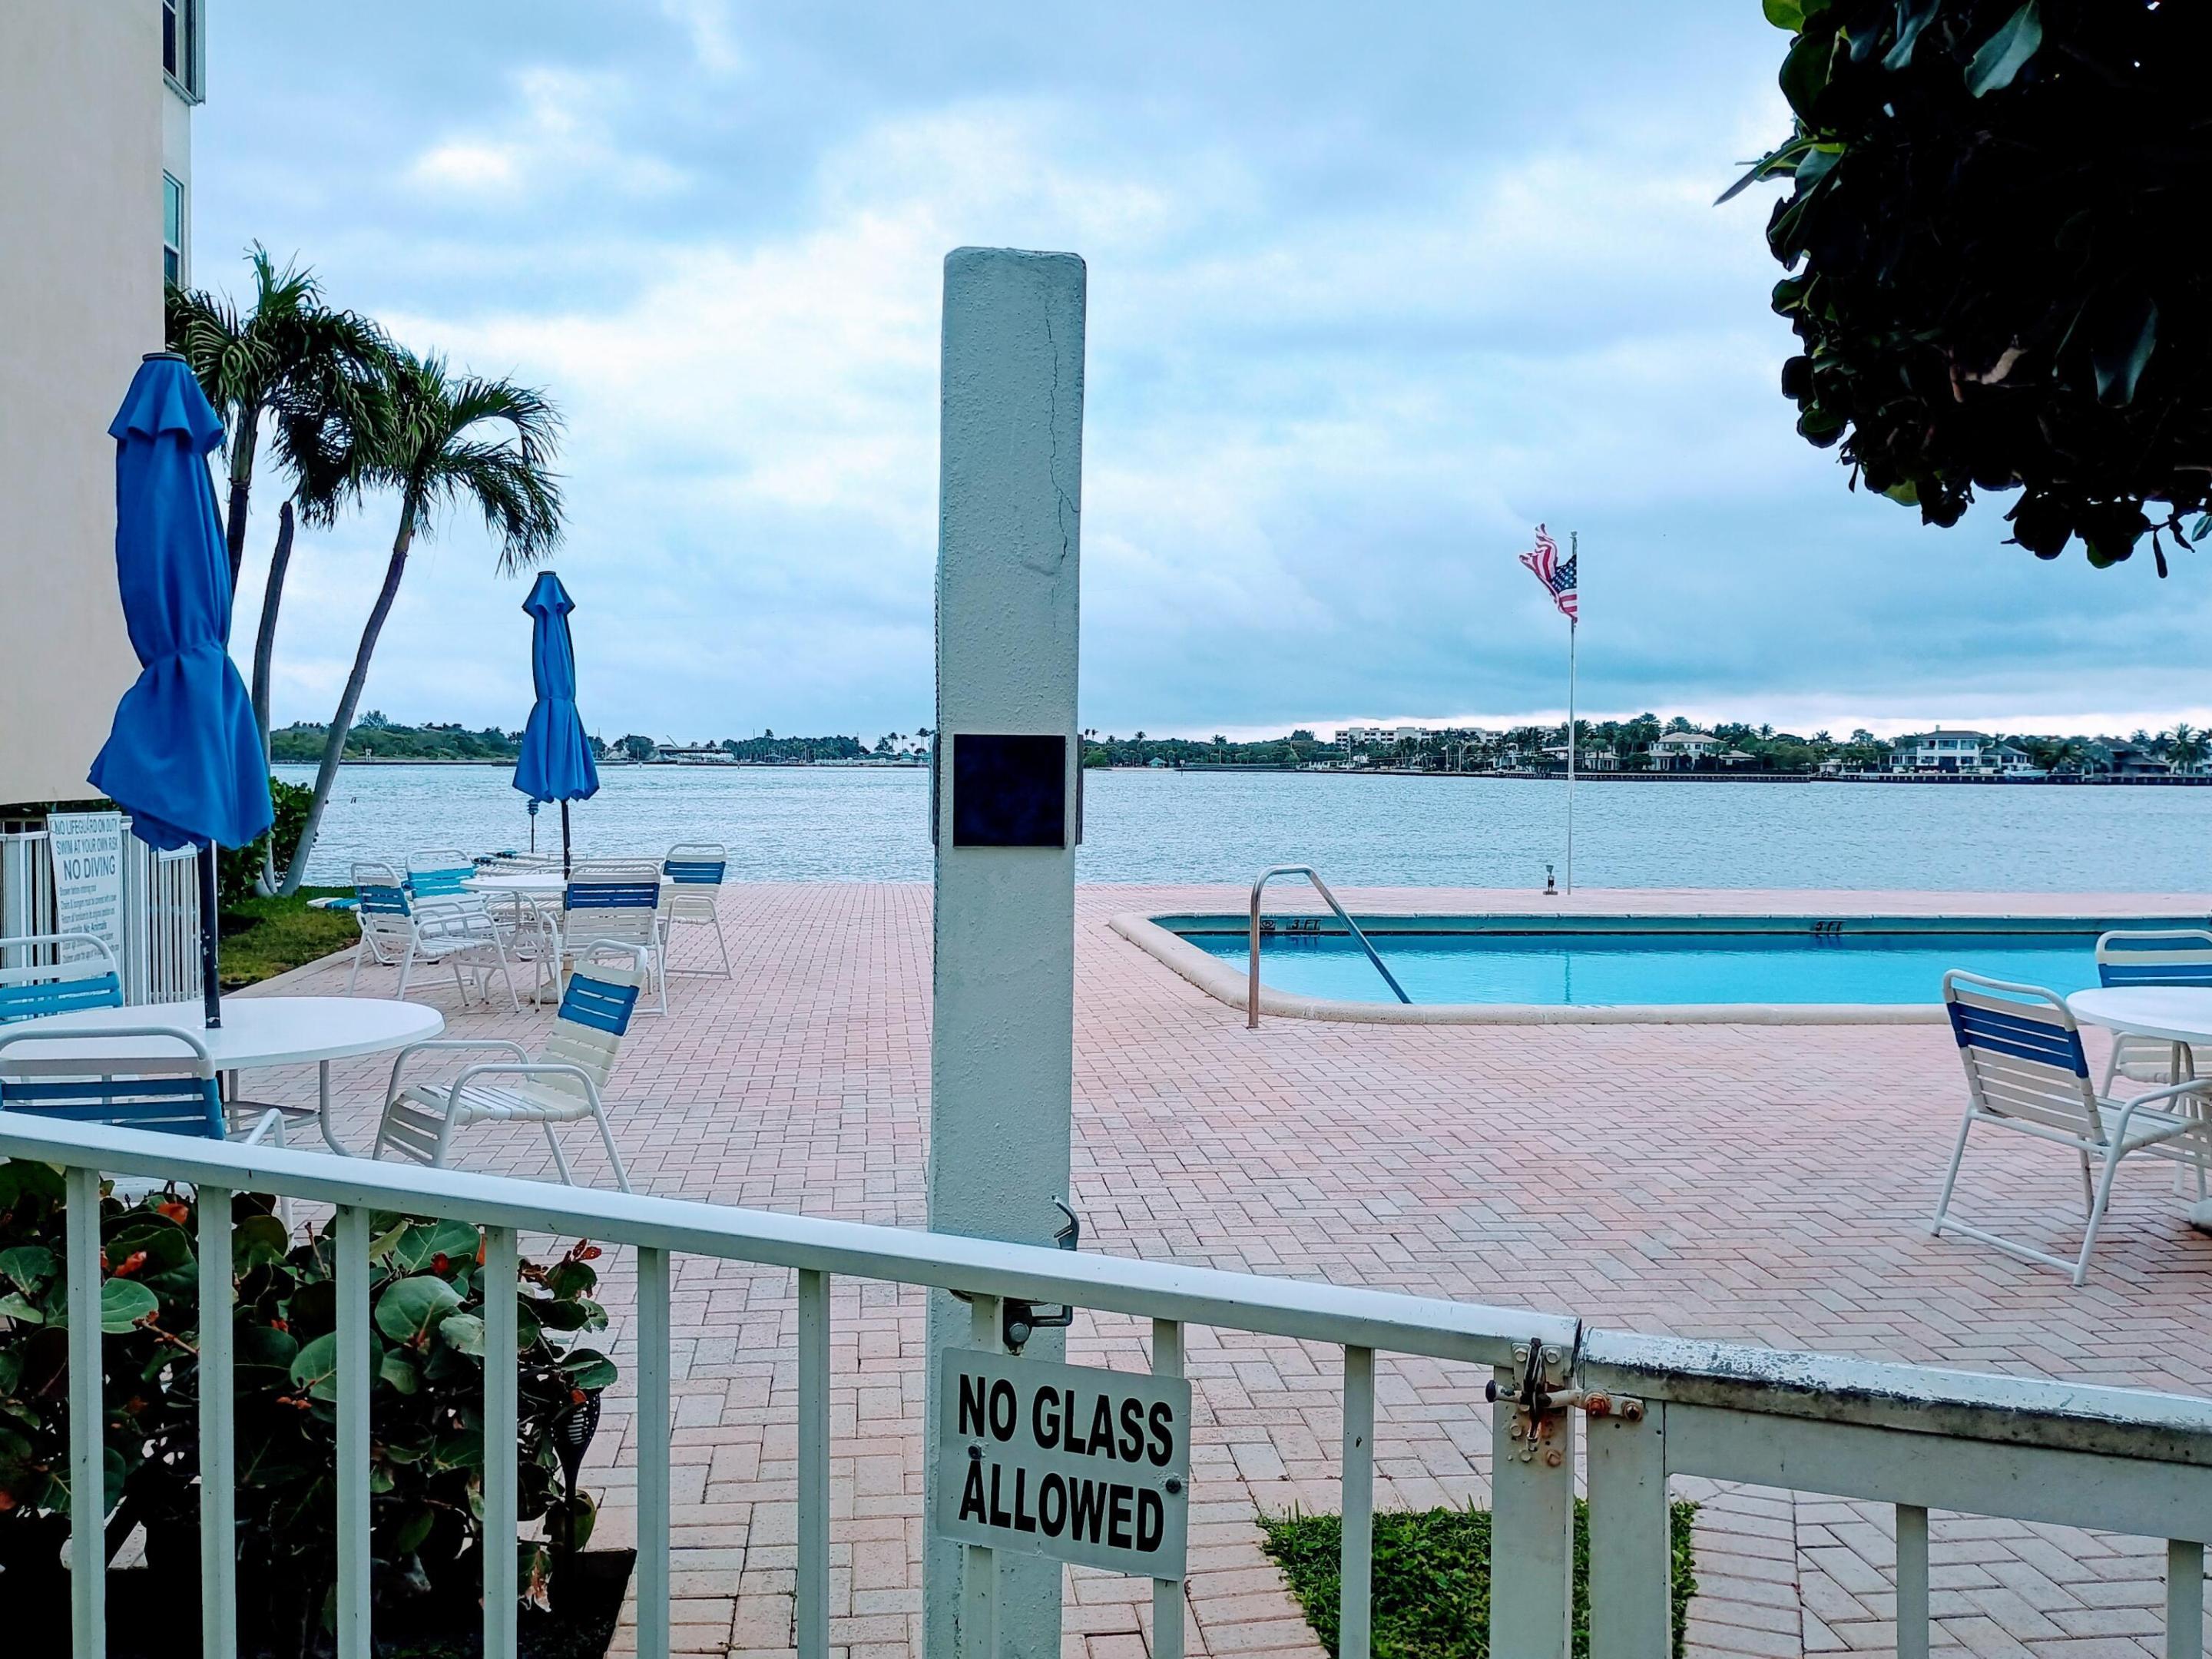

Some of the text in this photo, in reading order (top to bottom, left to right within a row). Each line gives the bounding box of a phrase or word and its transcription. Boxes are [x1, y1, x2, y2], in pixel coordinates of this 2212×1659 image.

[55, 820, 65, 836] NO
[56, 839, 73, 855] SWIM
[74, 839, 81, 853] AT
[81, 838, 97, 853] YOUR
[63, 855, 115, 881] NO DIVING
[1291, 919, 1321, 930] 3 FT
[1827, 921, 1846, 932] FT
[959, 1373, 1173, 1467] NO GLASS
[959, 1459, 1164, 1553] ALLOWED
